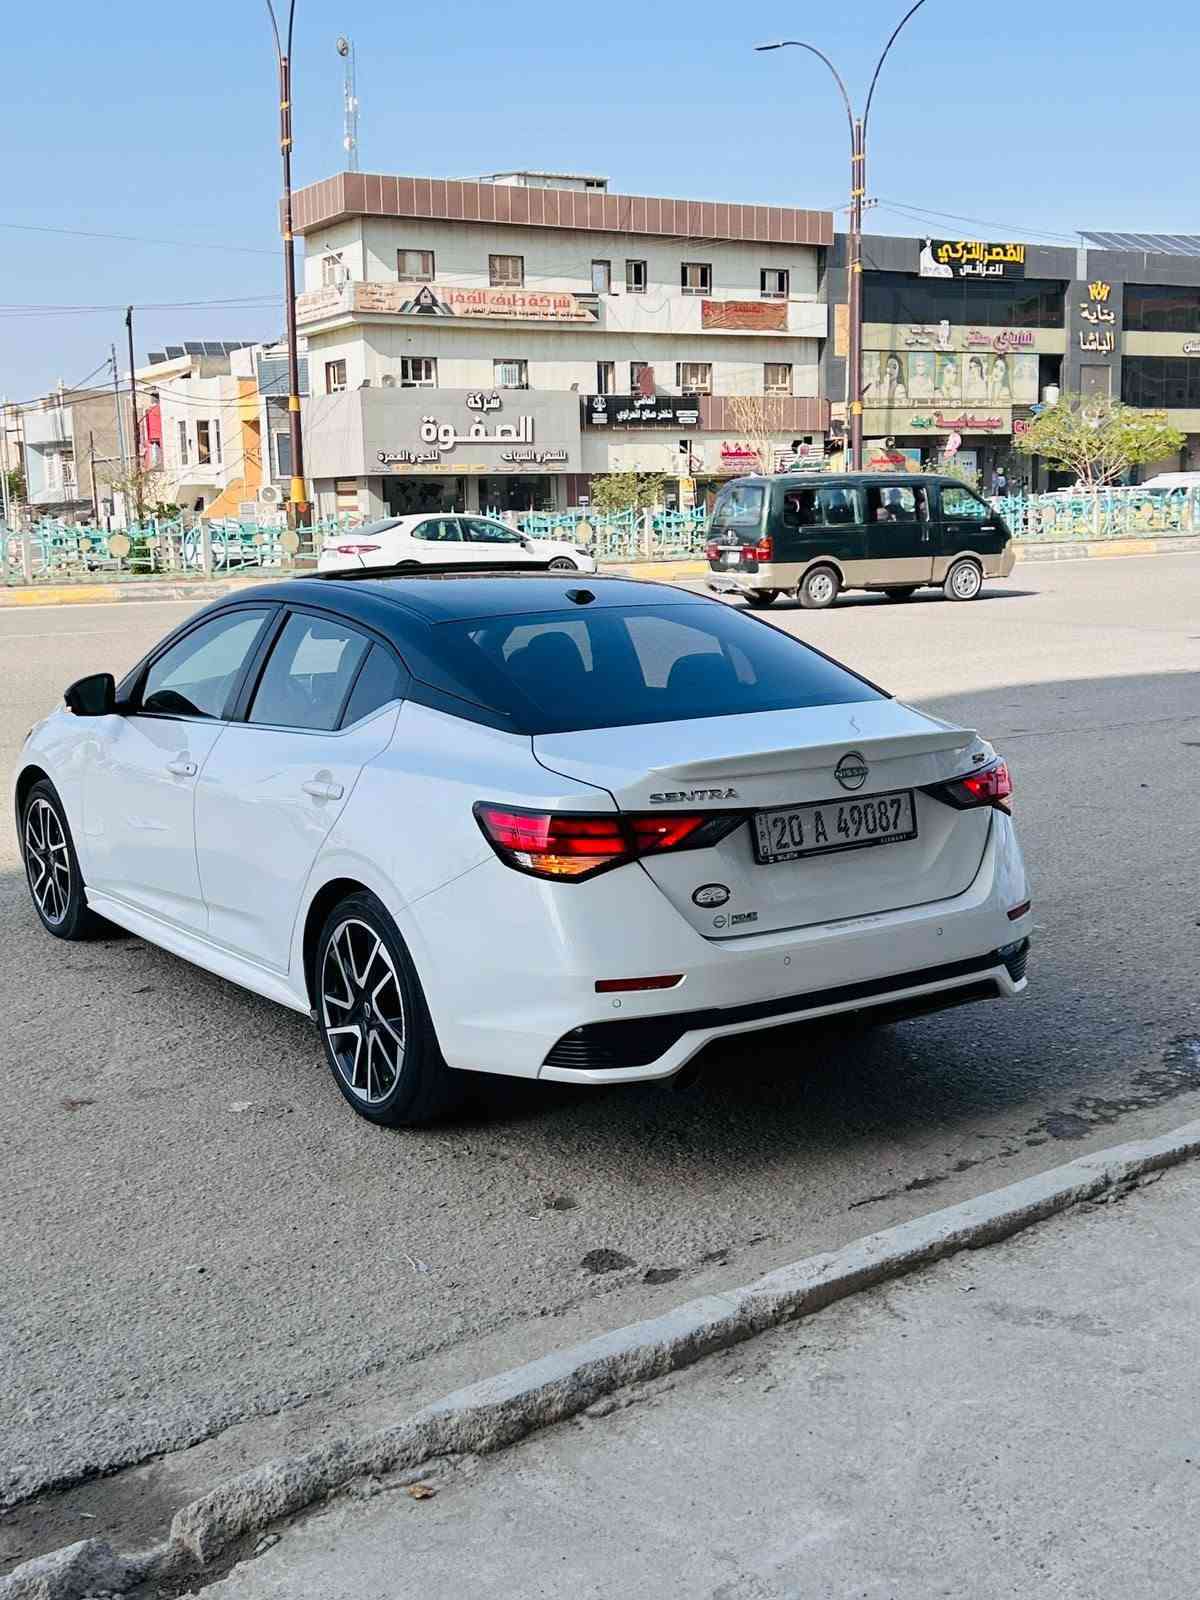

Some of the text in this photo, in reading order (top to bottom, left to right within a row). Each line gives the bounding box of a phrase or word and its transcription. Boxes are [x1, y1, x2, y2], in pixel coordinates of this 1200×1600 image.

[937, 241, 1024, 264] القصر التركي
[959, 262, 1004, 277] للعرائس
[529, 293, 571, 310] شركة
[1080, 303, 1115, 324] بناية
[1079, 331, 1115, 354] الباشا
[466, 391, 502, 411] شركة
[420, 416, 534, 450] الصفوة
[542, 450, 567, 463] للسفر
[649, 788, 738, 804] SENTRA
[772, 799, 902, 850] 20 A 49087
